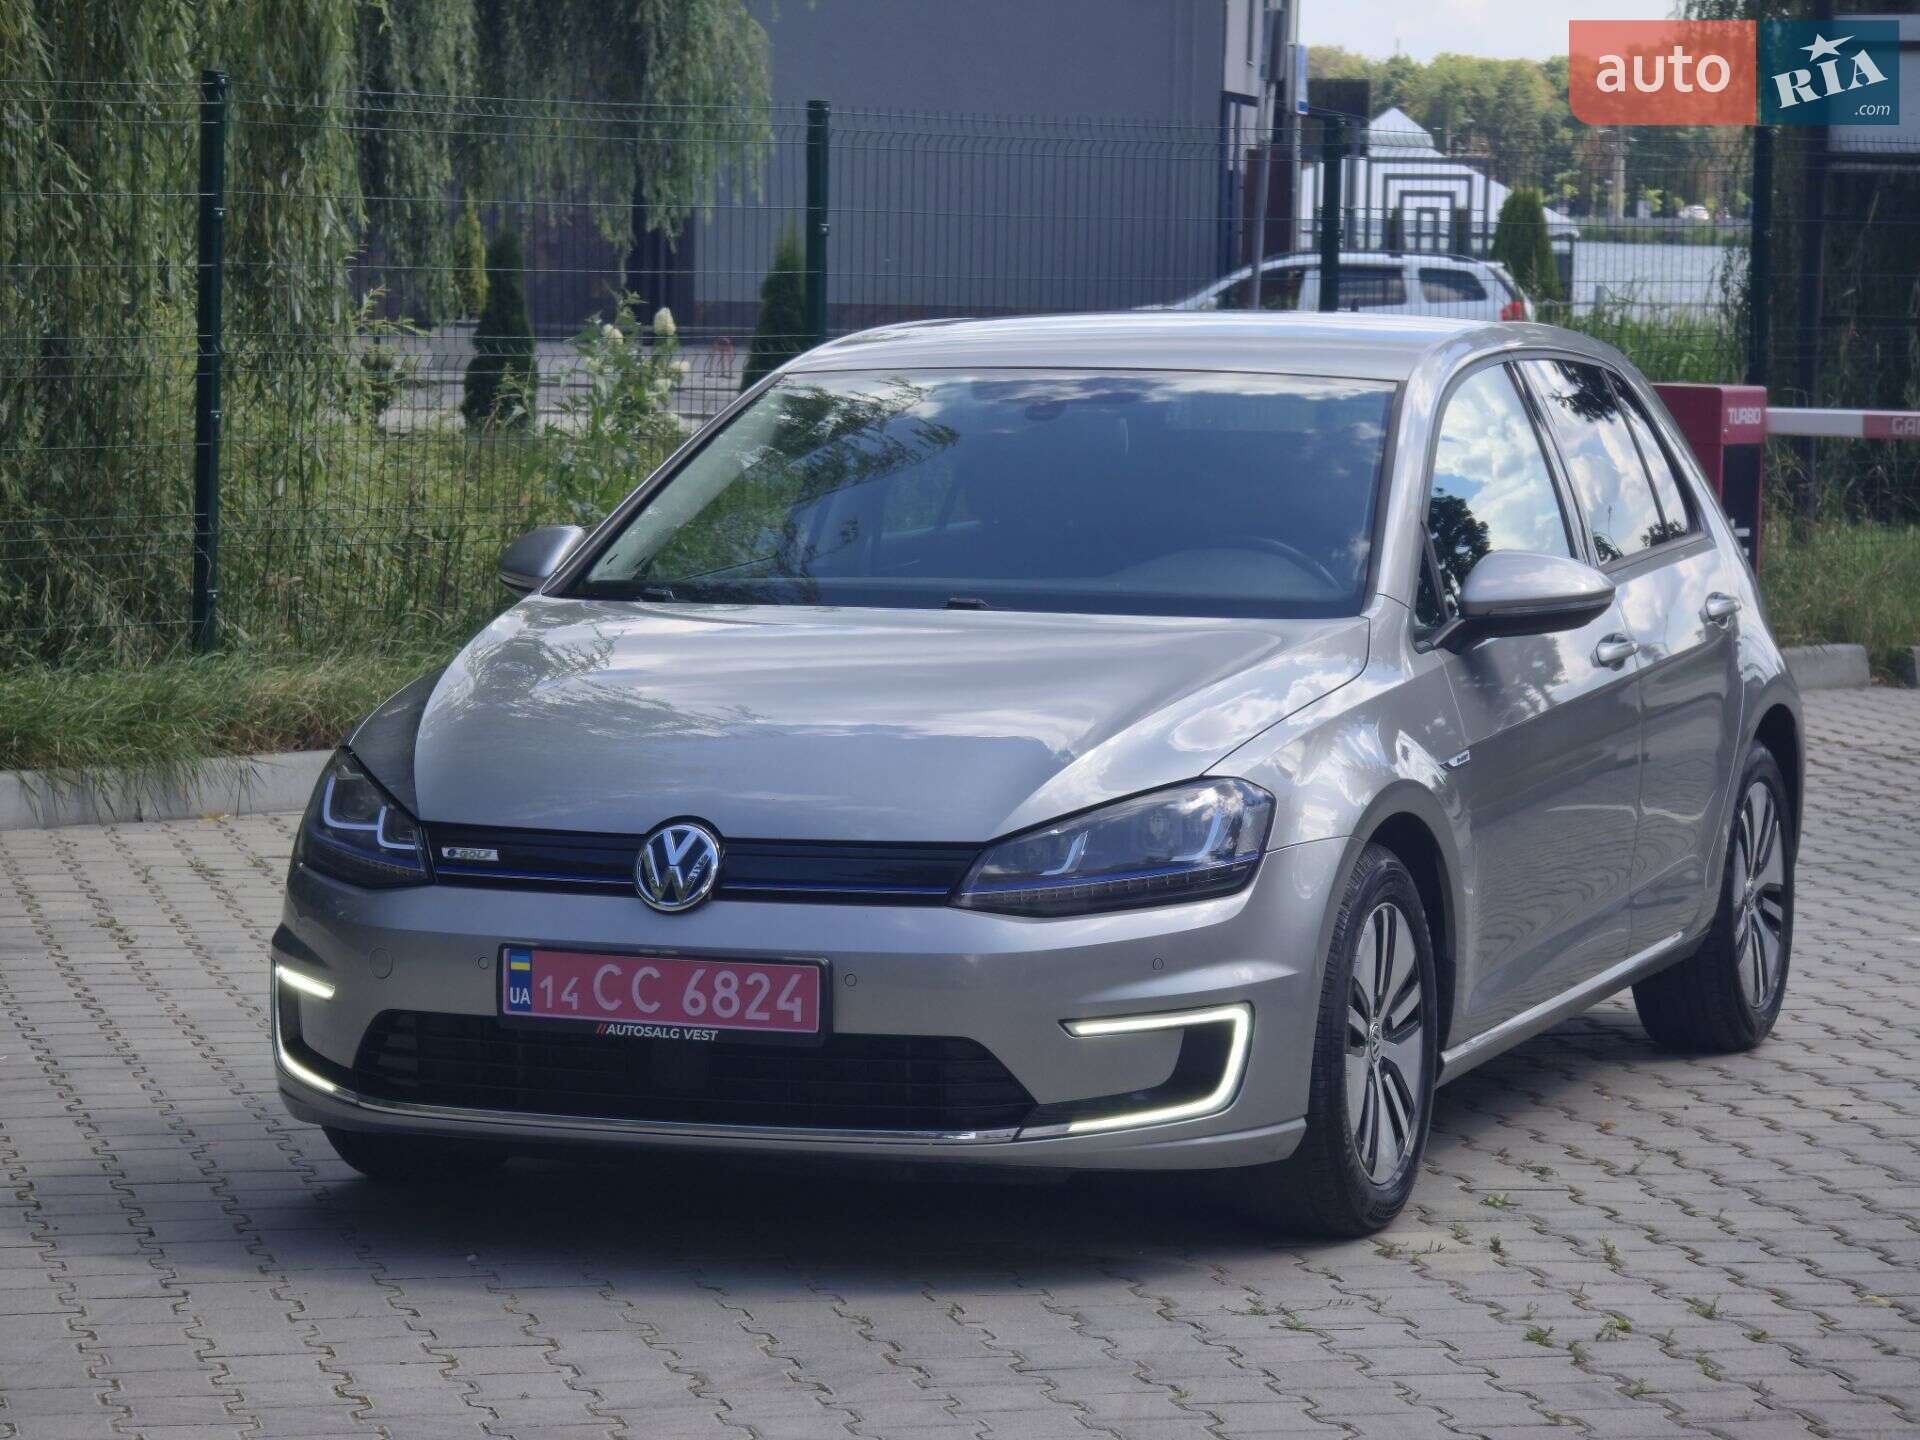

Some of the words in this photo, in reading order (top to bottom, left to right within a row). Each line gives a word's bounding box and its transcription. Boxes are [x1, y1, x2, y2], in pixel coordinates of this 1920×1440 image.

[1728, 408, 1761, 424] TURBO
[509, 986, 531, 1005] UA
[539, 975, 579, 1010] 14
[593, 964, 661, 1014] CC
[682, 969, 803, 1023] 6824
[684, 1028, 719, 1042] VEST
